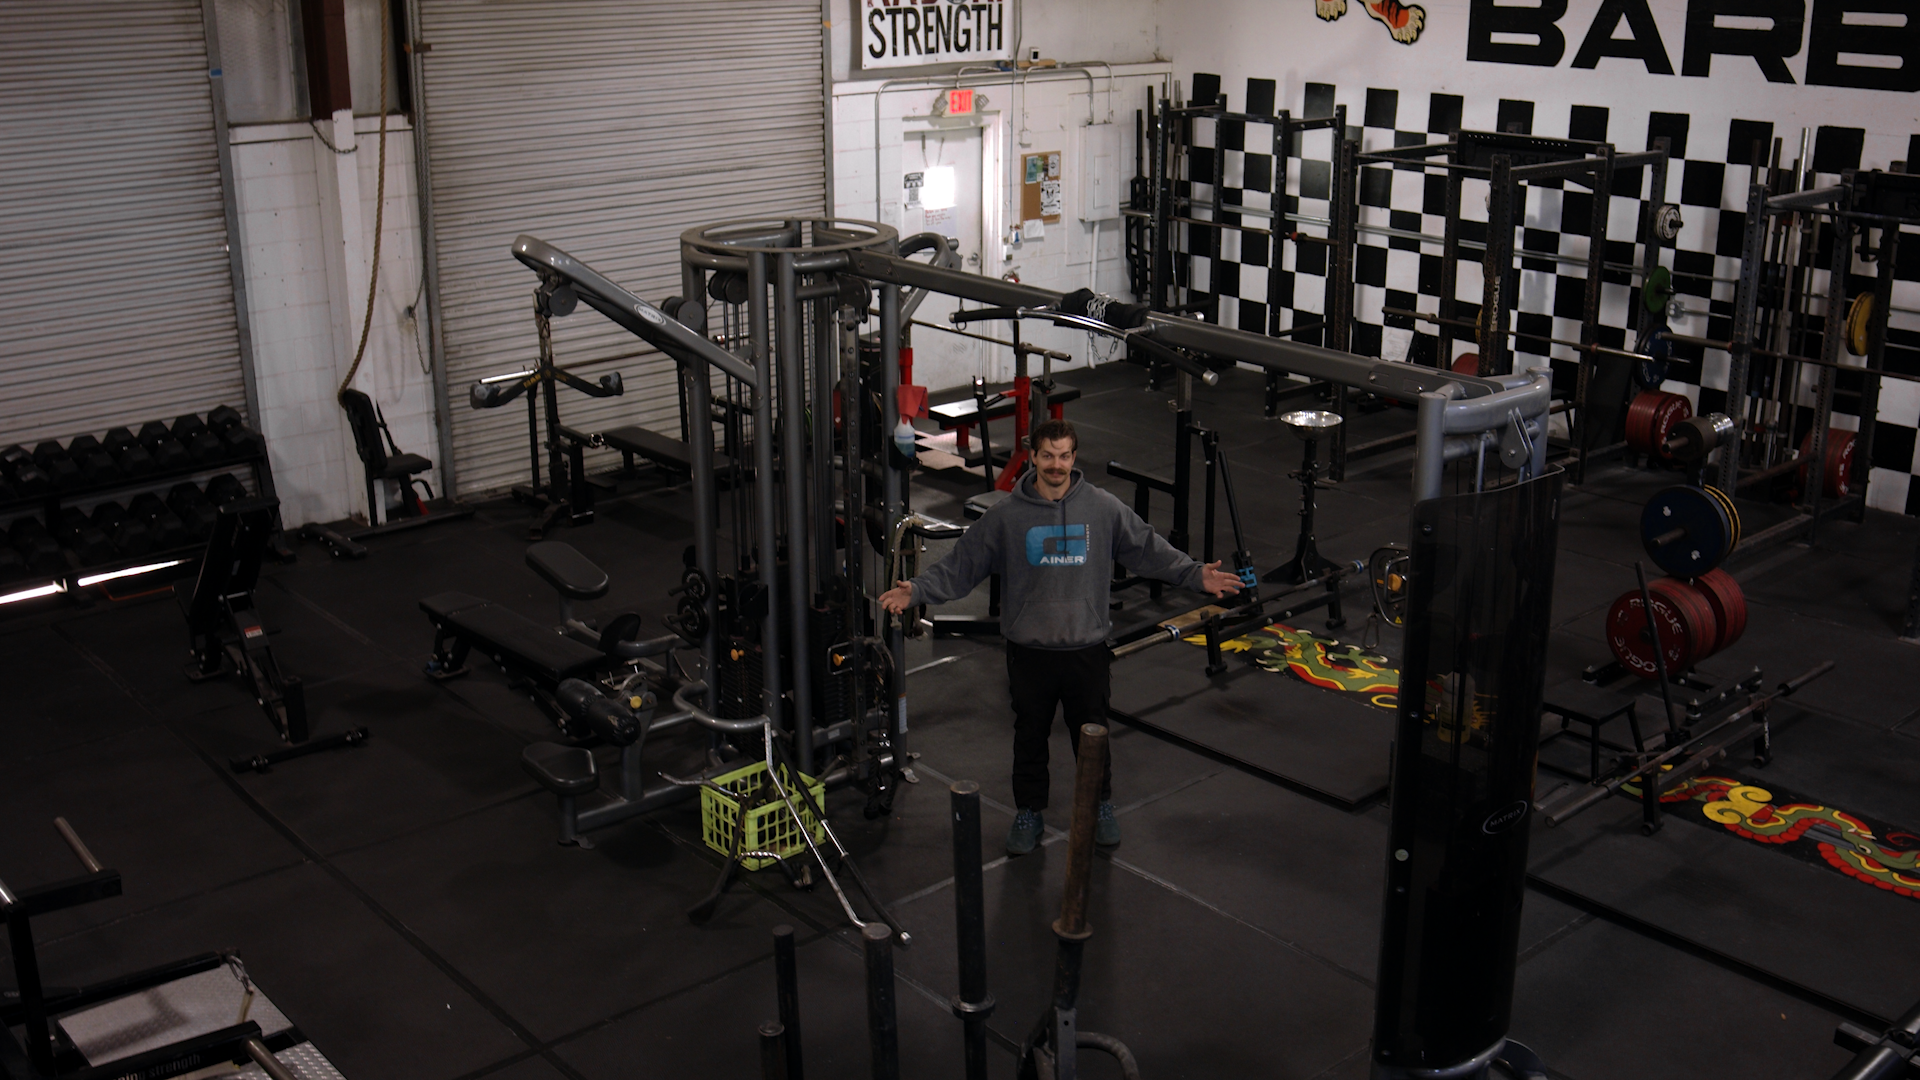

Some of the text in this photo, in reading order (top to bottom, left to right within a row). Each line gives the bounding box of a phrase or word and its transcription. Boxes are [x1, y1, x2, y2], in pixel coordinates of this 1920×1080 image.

[868, 4, 1003, 59] STRENGTH
[950, 90, 973, 114] EXIT
[1660, 399, 1683, 434] ROGUE
[1490, 807, 1522, 828] MATRIX
[148, 1053, 201, 1078] strength
